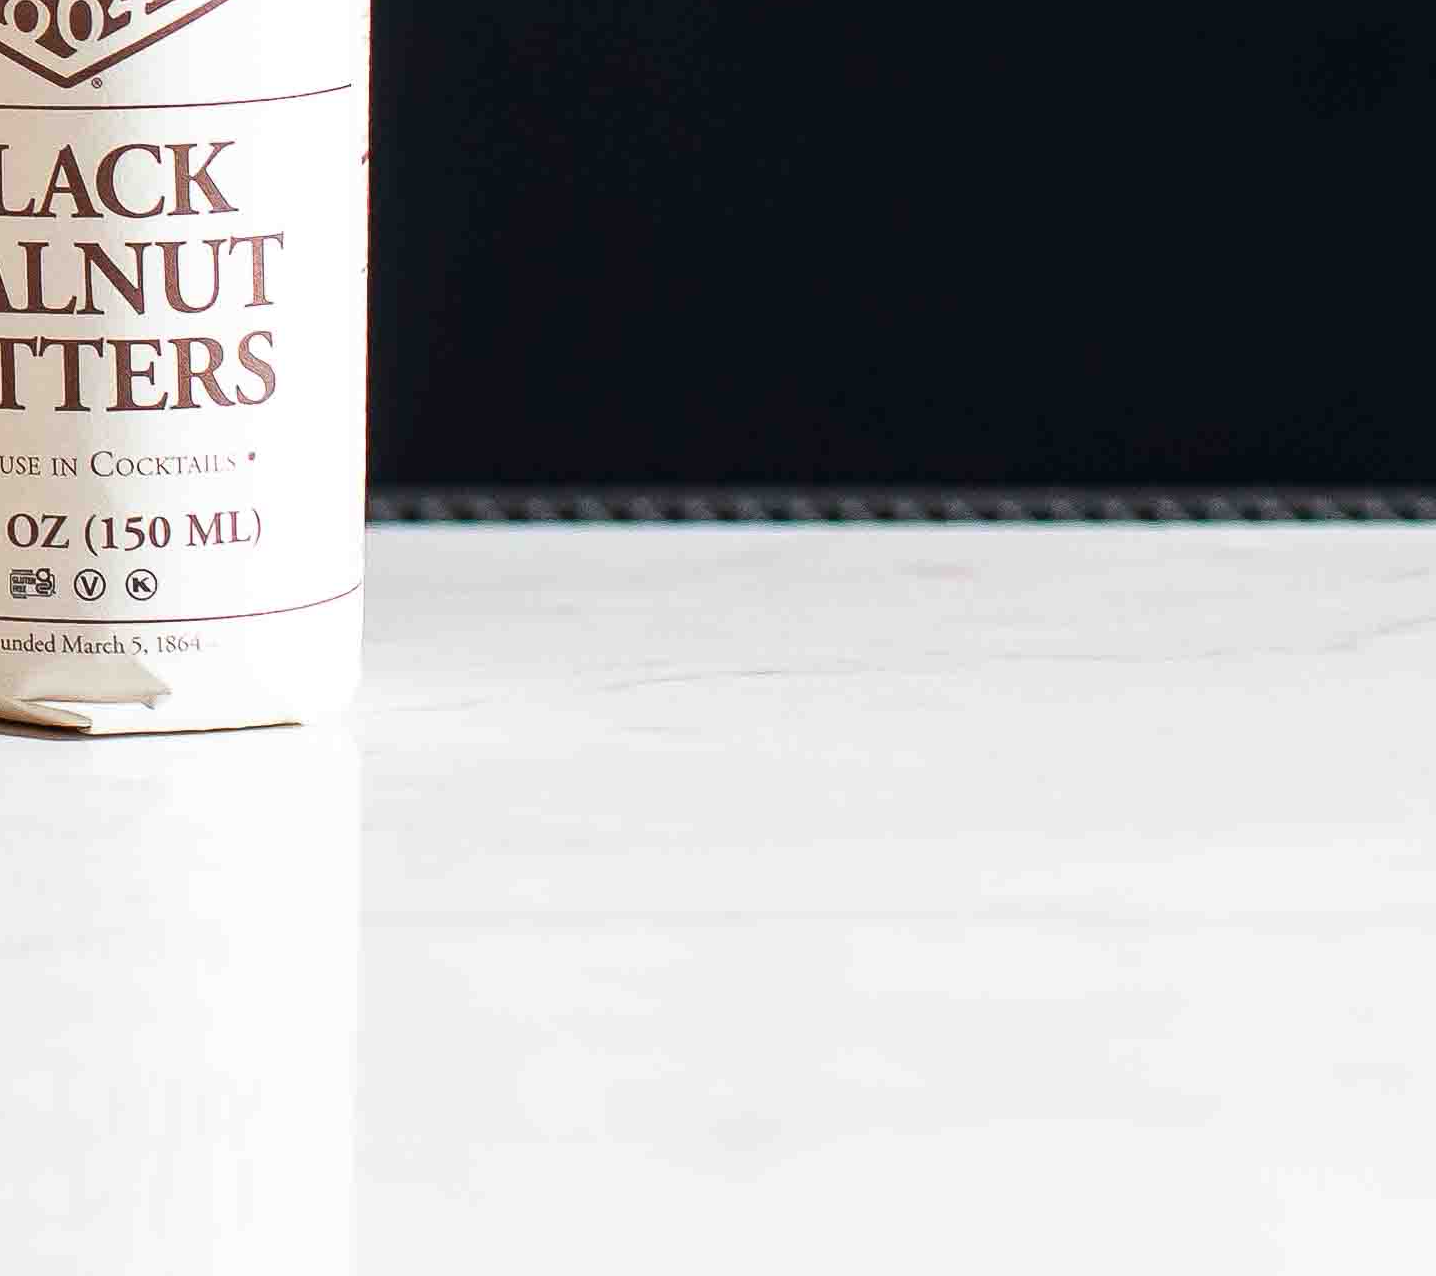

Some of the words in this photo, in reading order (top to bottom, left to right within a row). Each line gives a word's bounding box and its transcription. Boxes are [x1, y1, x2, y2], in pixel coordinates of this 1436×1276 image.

[7, 513, 69, 550] OZ
[84, 513, 171, 557] (150
[185, 507, 263, 547] ML)
[62, 634, 125, 654] March
[132, 634, 148, 655] 5,
[156, 634, 201, 653] 1864
